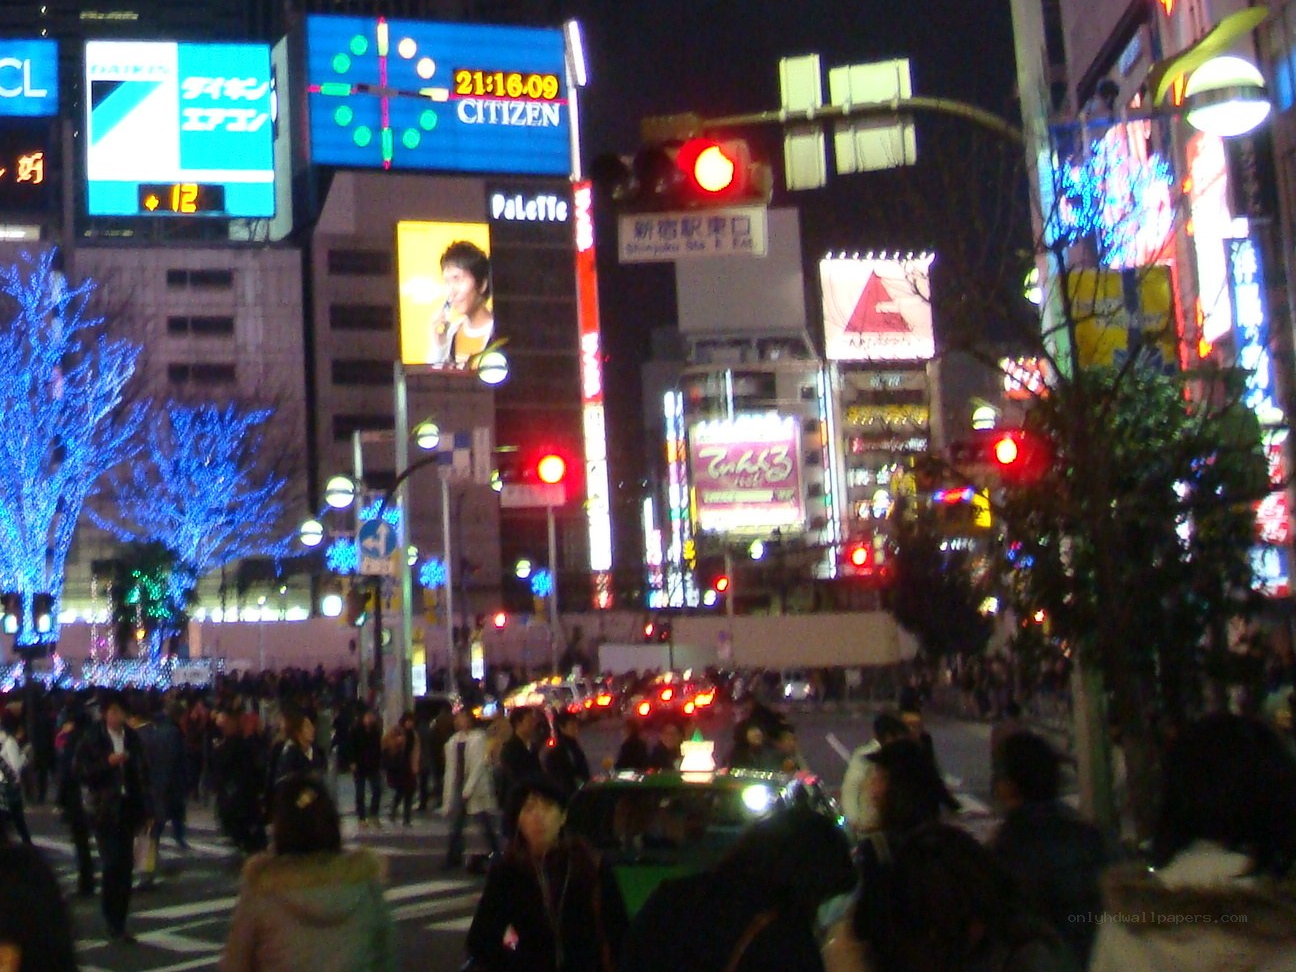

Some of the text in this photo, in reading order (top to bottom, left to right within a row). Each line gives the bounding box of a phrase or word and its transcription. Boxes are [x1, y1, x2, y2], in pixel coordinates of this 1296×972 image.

[182, 76, 269, 101] ダイキン
[182, 107, 269, 132] エアコン
[457, 99, 561, 127] CITIZEN
